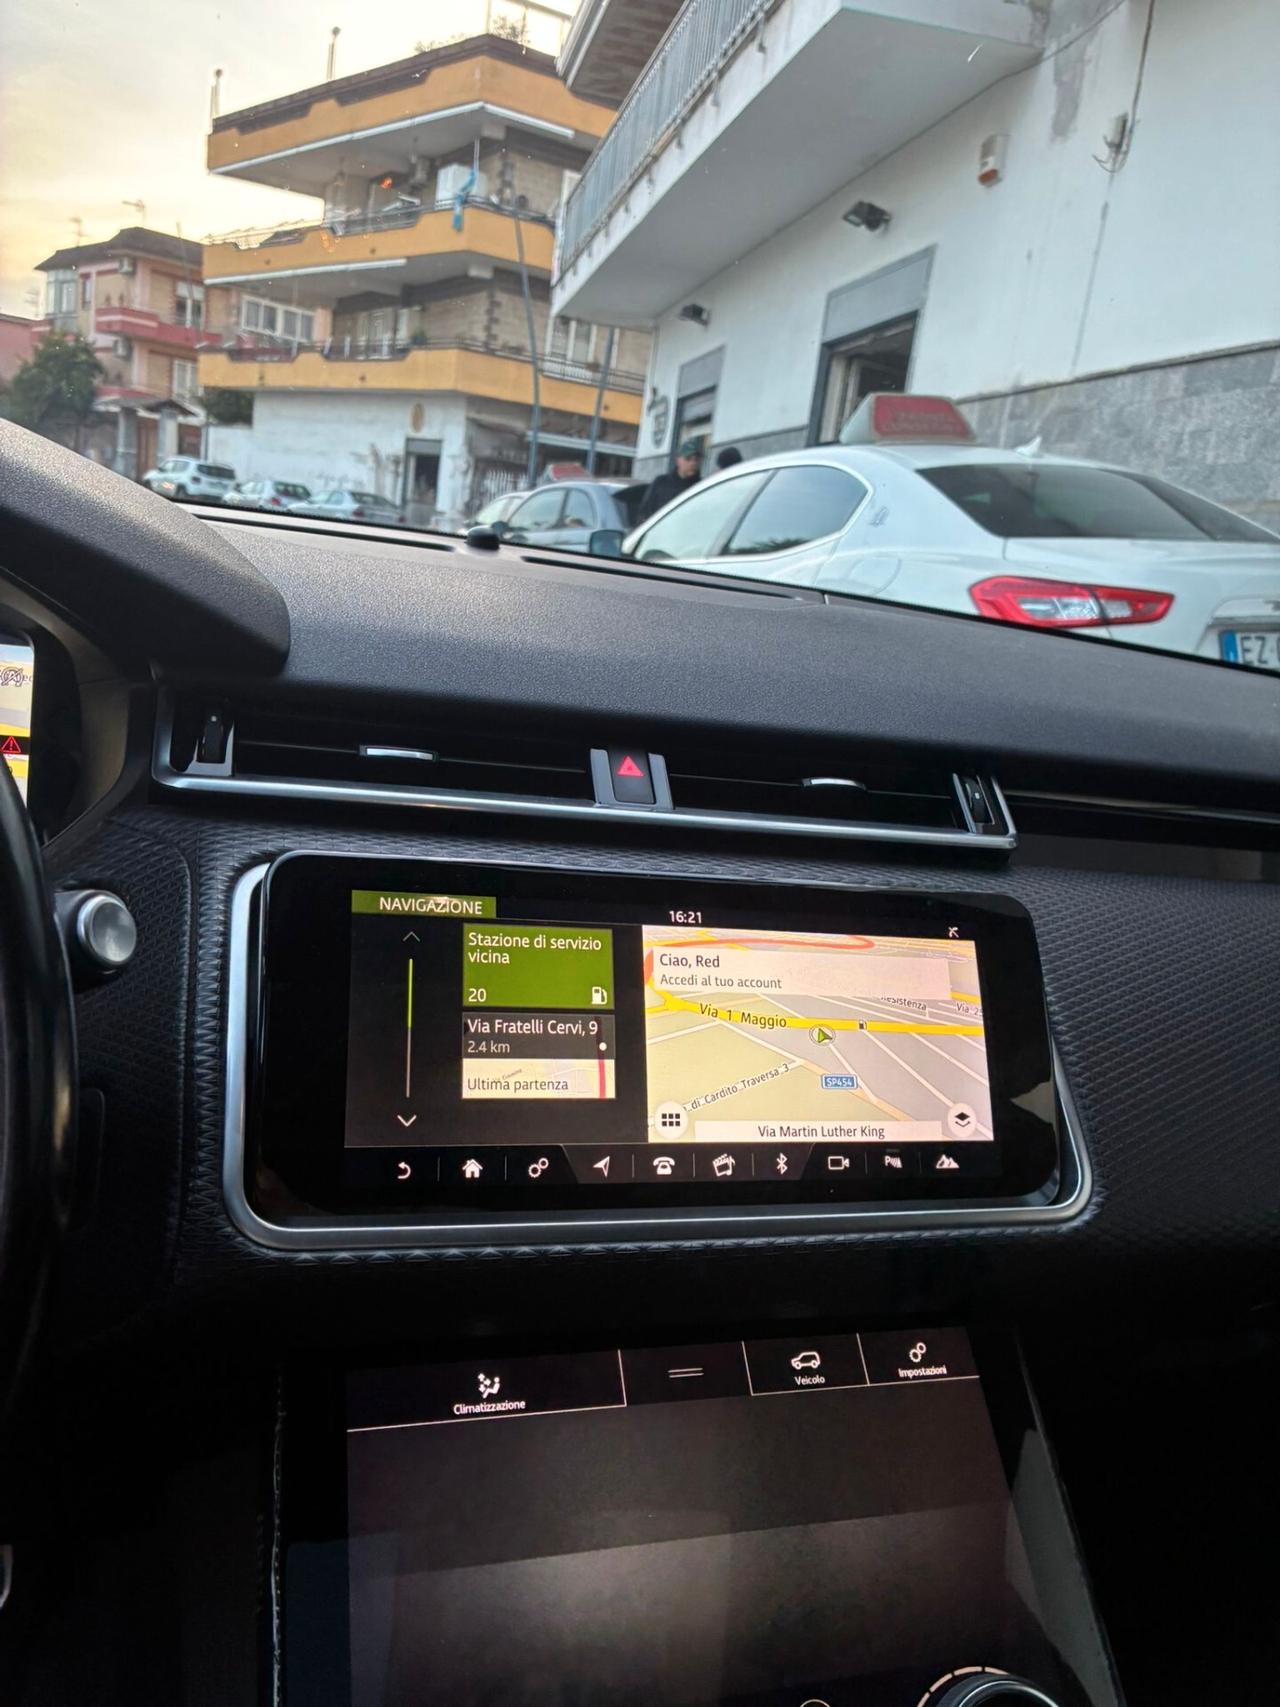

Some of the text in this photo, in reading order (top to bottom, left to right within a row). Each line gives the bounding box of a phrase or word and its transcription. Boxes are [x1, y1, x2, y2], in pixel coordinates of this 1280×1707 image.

[1241, 636, 1280, 666] EZ
[379, 896, 483, 915] NAVIGAZIONE
[669, 910, 702, 924] 16:21
[468, 932, 602, 950] Stazione di servizio
[468, 950, 510, 964] vicina
[659, 953, 720, 969] Ciao, Red
[660, 974, 782, 989] Accedi al tuo account
[468, 988, 487, 1003] 20
[881, 997, 927, 1011] esistenza
[956, 1003, 970, 1014] Via
[700, 1003, 787, 1029] Via 1 Maggio
[467, 1018, 598, 1036] Via Fratelli Cervi, 9
[467, 1040, 510, 1053] 2.4 km
[467, 1078, 569, 1093] Ultima partenza
[691, 1100, 701, 1110] di
[704, 1085, 738, 1104] Cardito
[741, 1070, 780, 1090] Traversa
[783, 1063, 790, 1073] 3
[826, 1077, 852, 1088] SP454
[758, 1126, 885, 1140] Via Martin Luther King
[898, 1364, 947, 1379] Impostazioni
[794, 1374, 826, 1386] Veicolo
[453, 1400, 526, 1415] Climatizzazione
